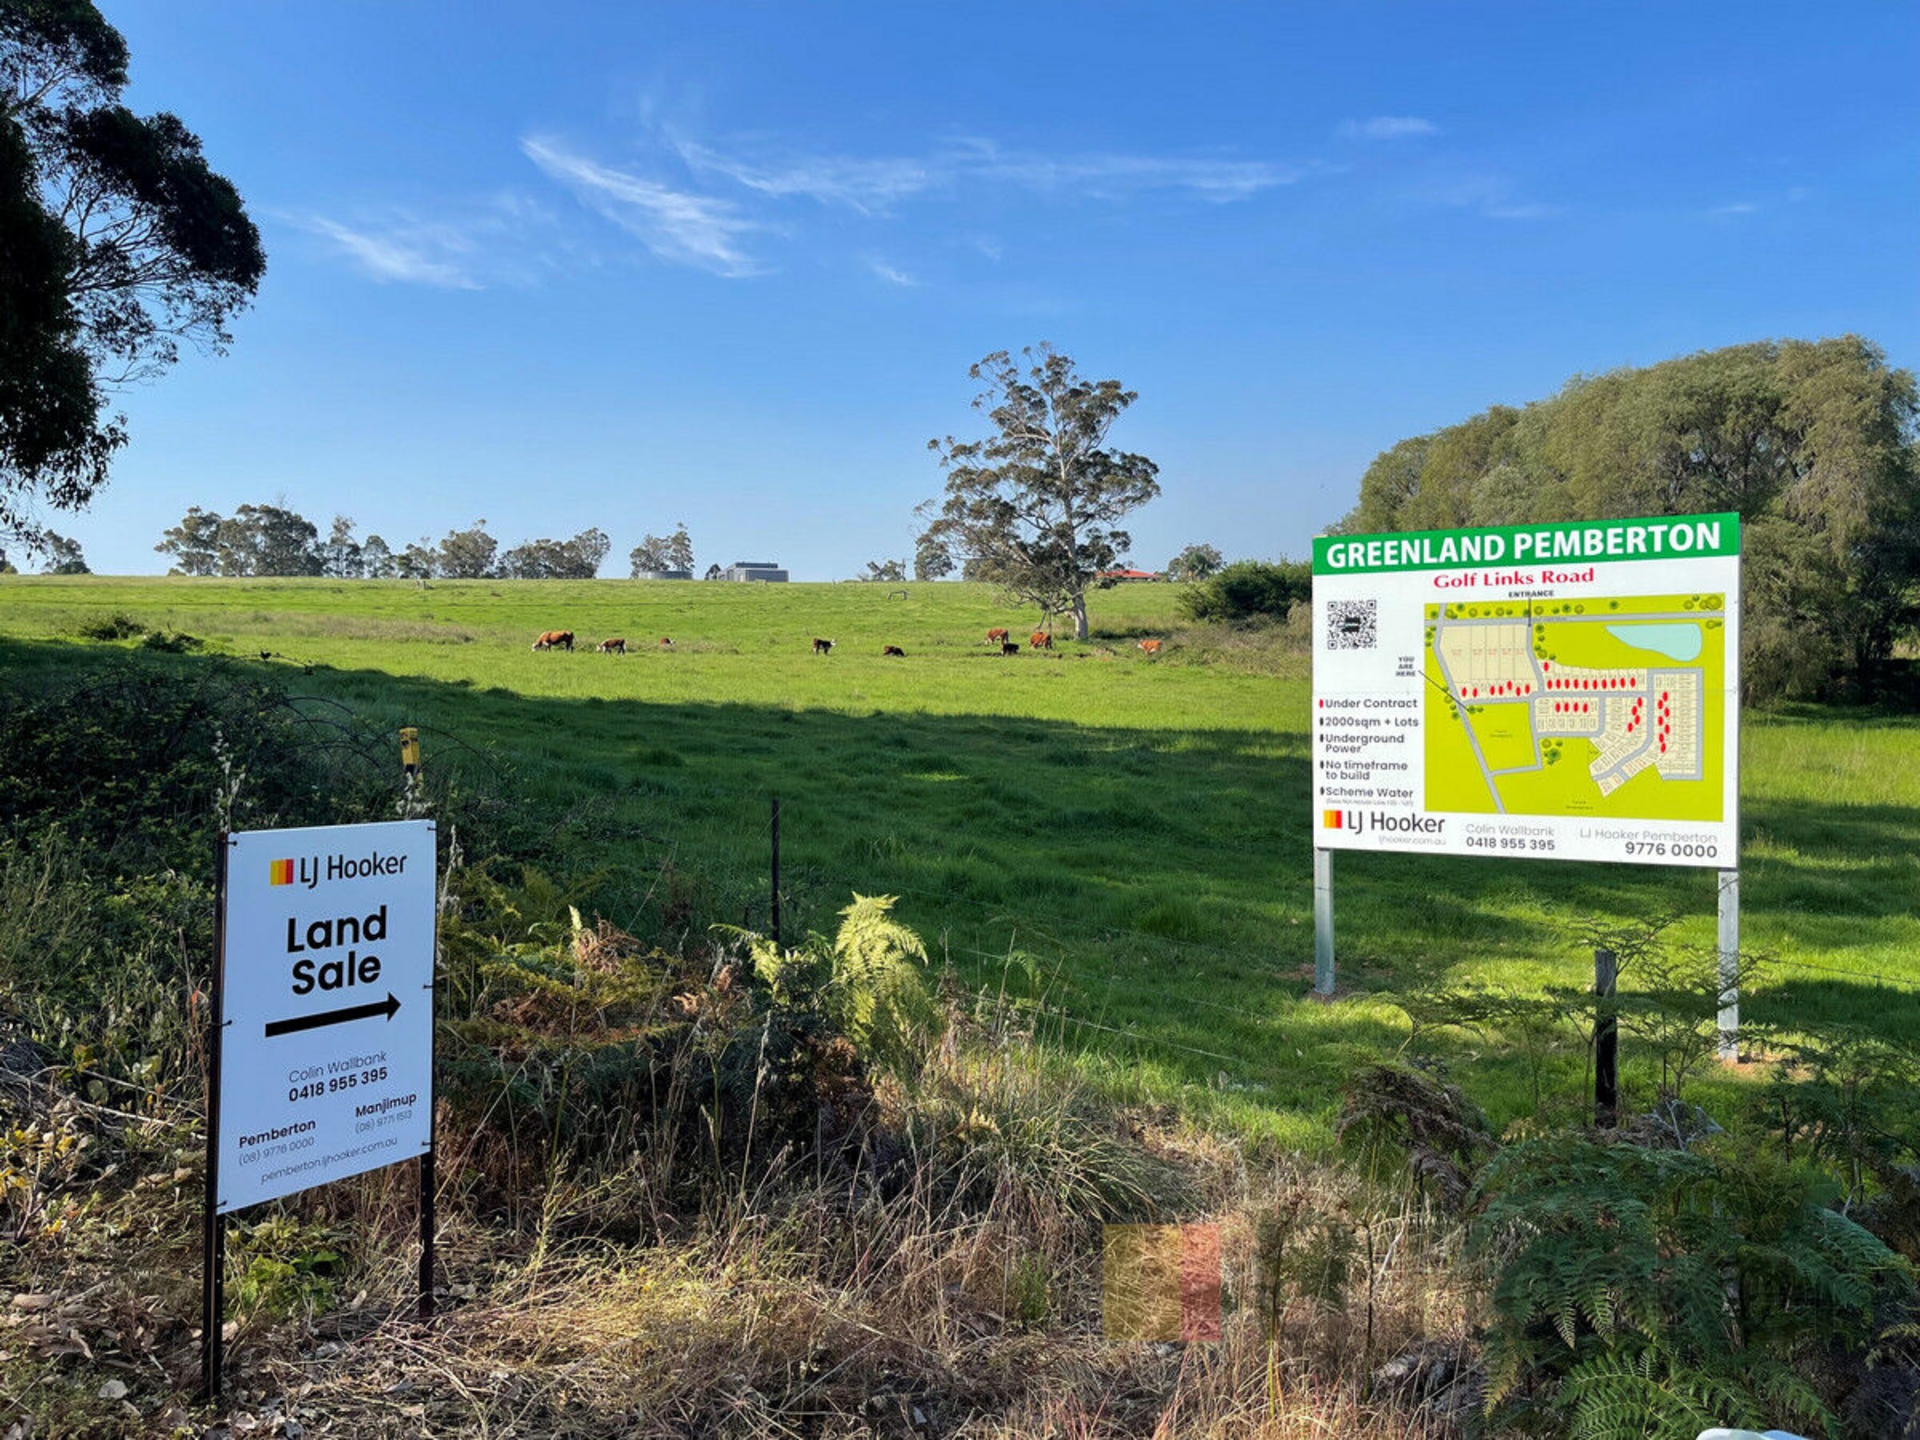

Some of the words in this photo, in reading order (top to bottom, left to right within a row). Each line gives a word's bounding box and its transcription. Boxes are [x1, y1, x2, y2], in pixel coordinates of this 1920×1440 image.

[1327, 535, 1505, 568] GREENLAND
[1514, 522, 1720, 559] PEMBERTON
[1434, 573, 1477, 588] Golf
[1484, 571, 1534, 586] Links
[1542, 568, 1594, 583] Road
[1508, 590, 1554, 598] ENTRANCE
[1325, 699, 1360, 708] Under
[1363, 699, 1418, 708] Contract
[1325, 717, 1380, 729] 2000sqm
[1395, 717, 1419, 727] Lots
[1325, 734, 1404, 746] Underground
[1325, 744, 1361, 753] Power
[1326, 761, 1341, 769] No
[1344, 760, 1408, 770] timeframe
[1326, 771, 1338, 779] to
[1341, 771, 1370, 780] build
[1326, 786, 1373, 797] Scheme
[1377, 788, 1413, 798] Water
[1348, 810, 1362, 834] LJ
[1371, 813, 1445, 833] Hooker
[1466, 824, 1496, 834] Colin
[1499, 825, 1555, 836] Wallbank
[1595, 829, 1640, 840] Hooker
[1643, 830, 1718, 843] Pemberton
[1466, 836, 1496, 848] 0418
[1500, 838, 1525, 849] 955
[1530, 839, 1555, 850] 395
[1625, 841, 1666, 856] 9776
[1671, 844, 1718, 858] 0000
[300, 856, 319, 889] LJ
[328, 851, 407, 880] Hooker
[287, 905, 387, 953] Land
[292, 951, 381, 995] Sale
[289, 1066, 324, 1083] Colin
[327, 1050, 387, 1074] Wallbank
[289, 1082, 324, 1101] 0418
[329, 1074, 357, 1092] 955
[361, 1066, 388, 1085] 395
[355, 1094, 417, 1117] Manjimup
[239, 1120, 316, 1148] Pemberton
[289, 1136, 315, 1151] 0000
